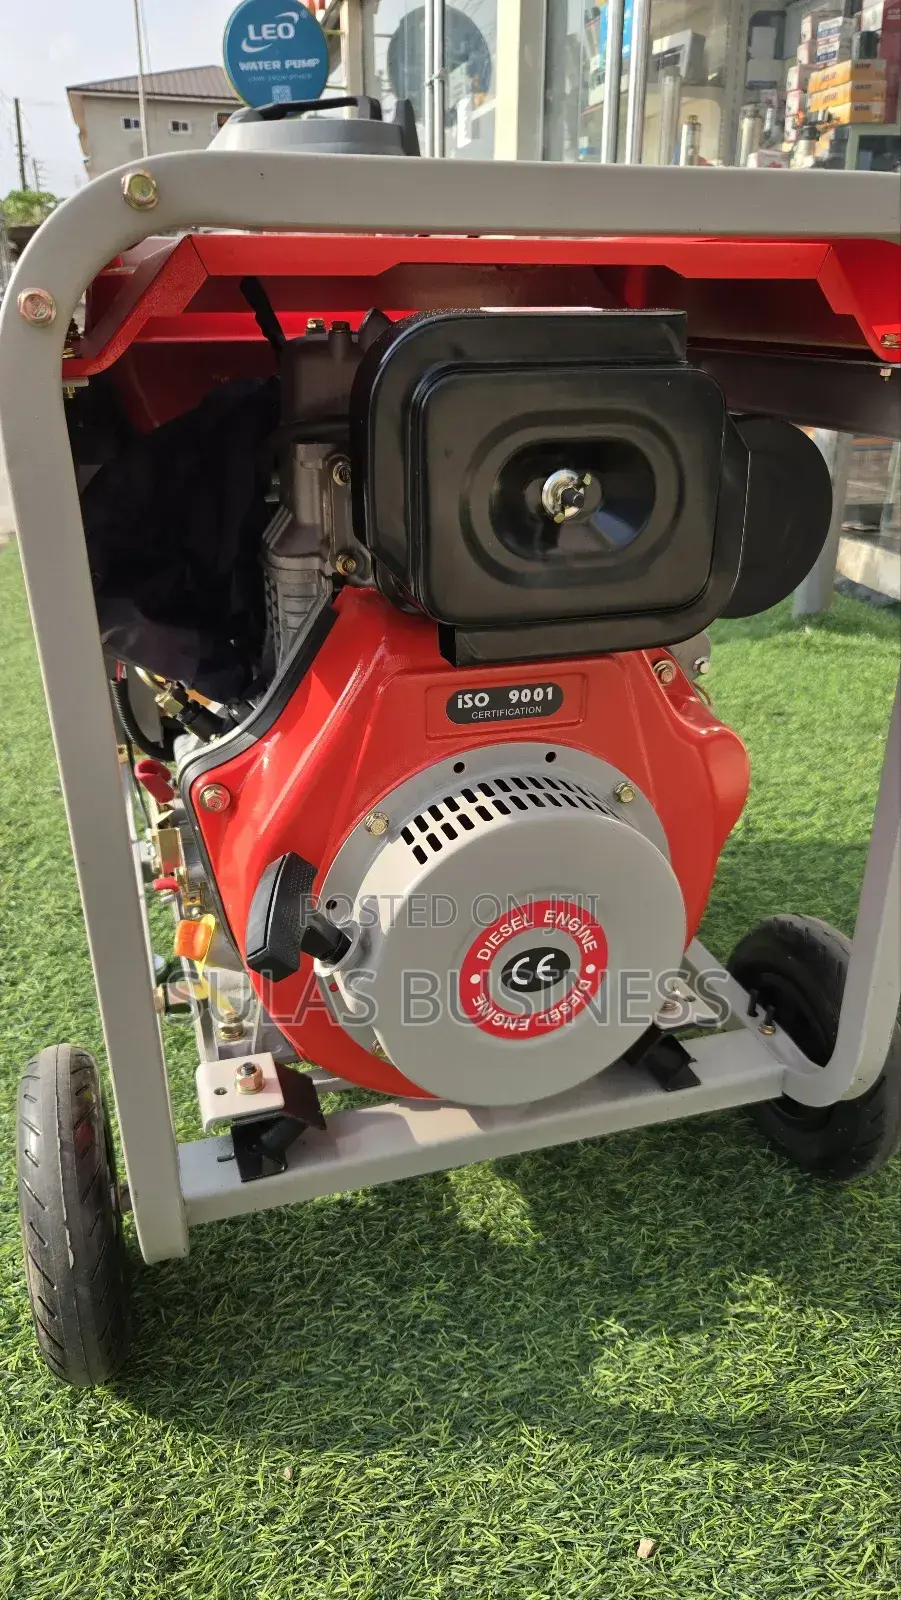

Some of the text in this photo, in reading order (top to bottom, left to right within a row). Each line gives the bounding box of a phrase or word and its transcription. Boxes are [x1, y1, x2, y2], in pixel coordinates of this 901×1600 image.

[247, 22, 296, 41] LEO
[238, 57, 321, 72] WATER PUMP
[508, 686, 554, 704] 9001
[471, 705, 542, 720] CERTIFICATION
[476, 909, 598, 961] DIESEL ENGINE
[511, 953, 555, 986] CE
[471, 978, 593, 1031] DIESEL ENGINE
